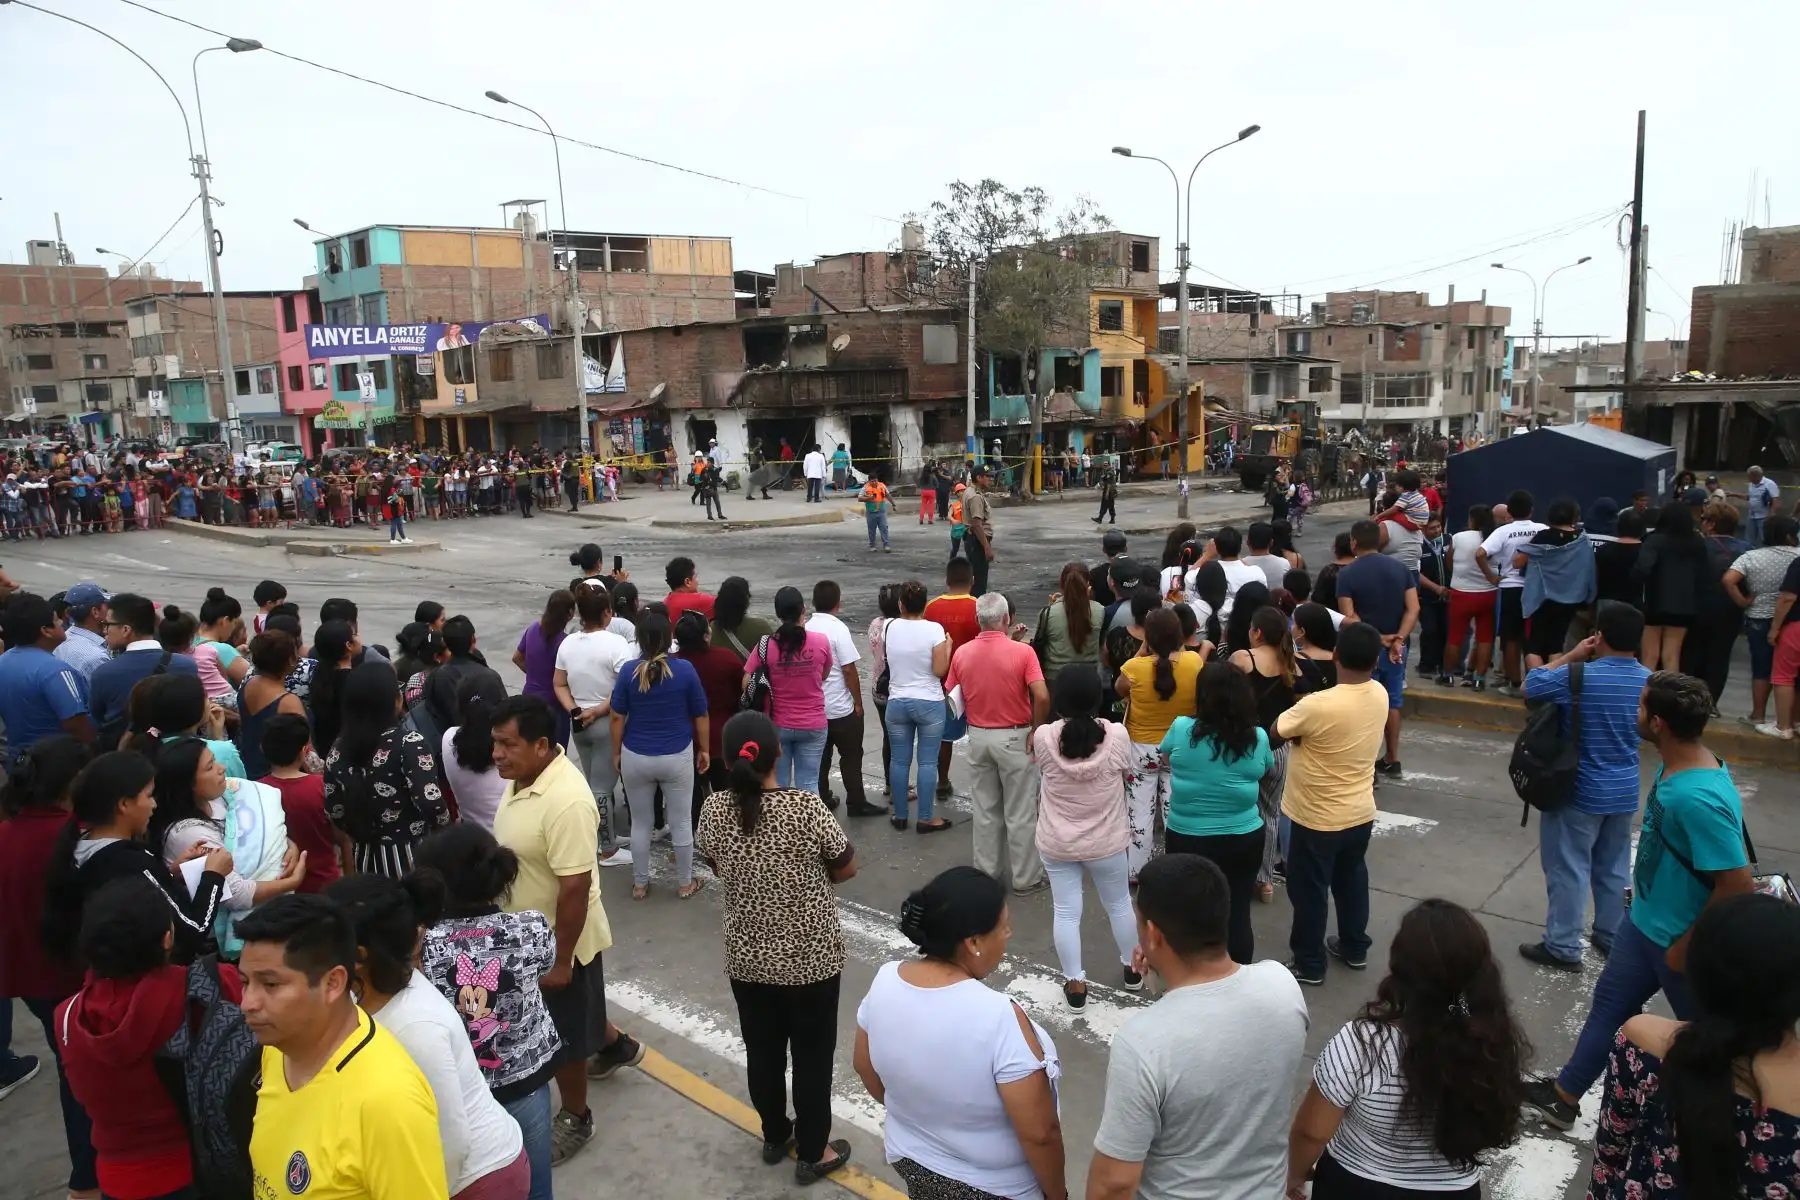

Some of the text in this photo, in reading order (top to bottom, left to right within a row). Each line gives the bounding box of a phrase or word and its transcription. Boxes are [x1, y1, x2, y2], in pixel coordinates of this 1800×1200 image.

[390, 326, 427, 336] ORTIZ
[312, 327, 388, 347] ANYELA
[389, 336, 426, 344] CANALES
